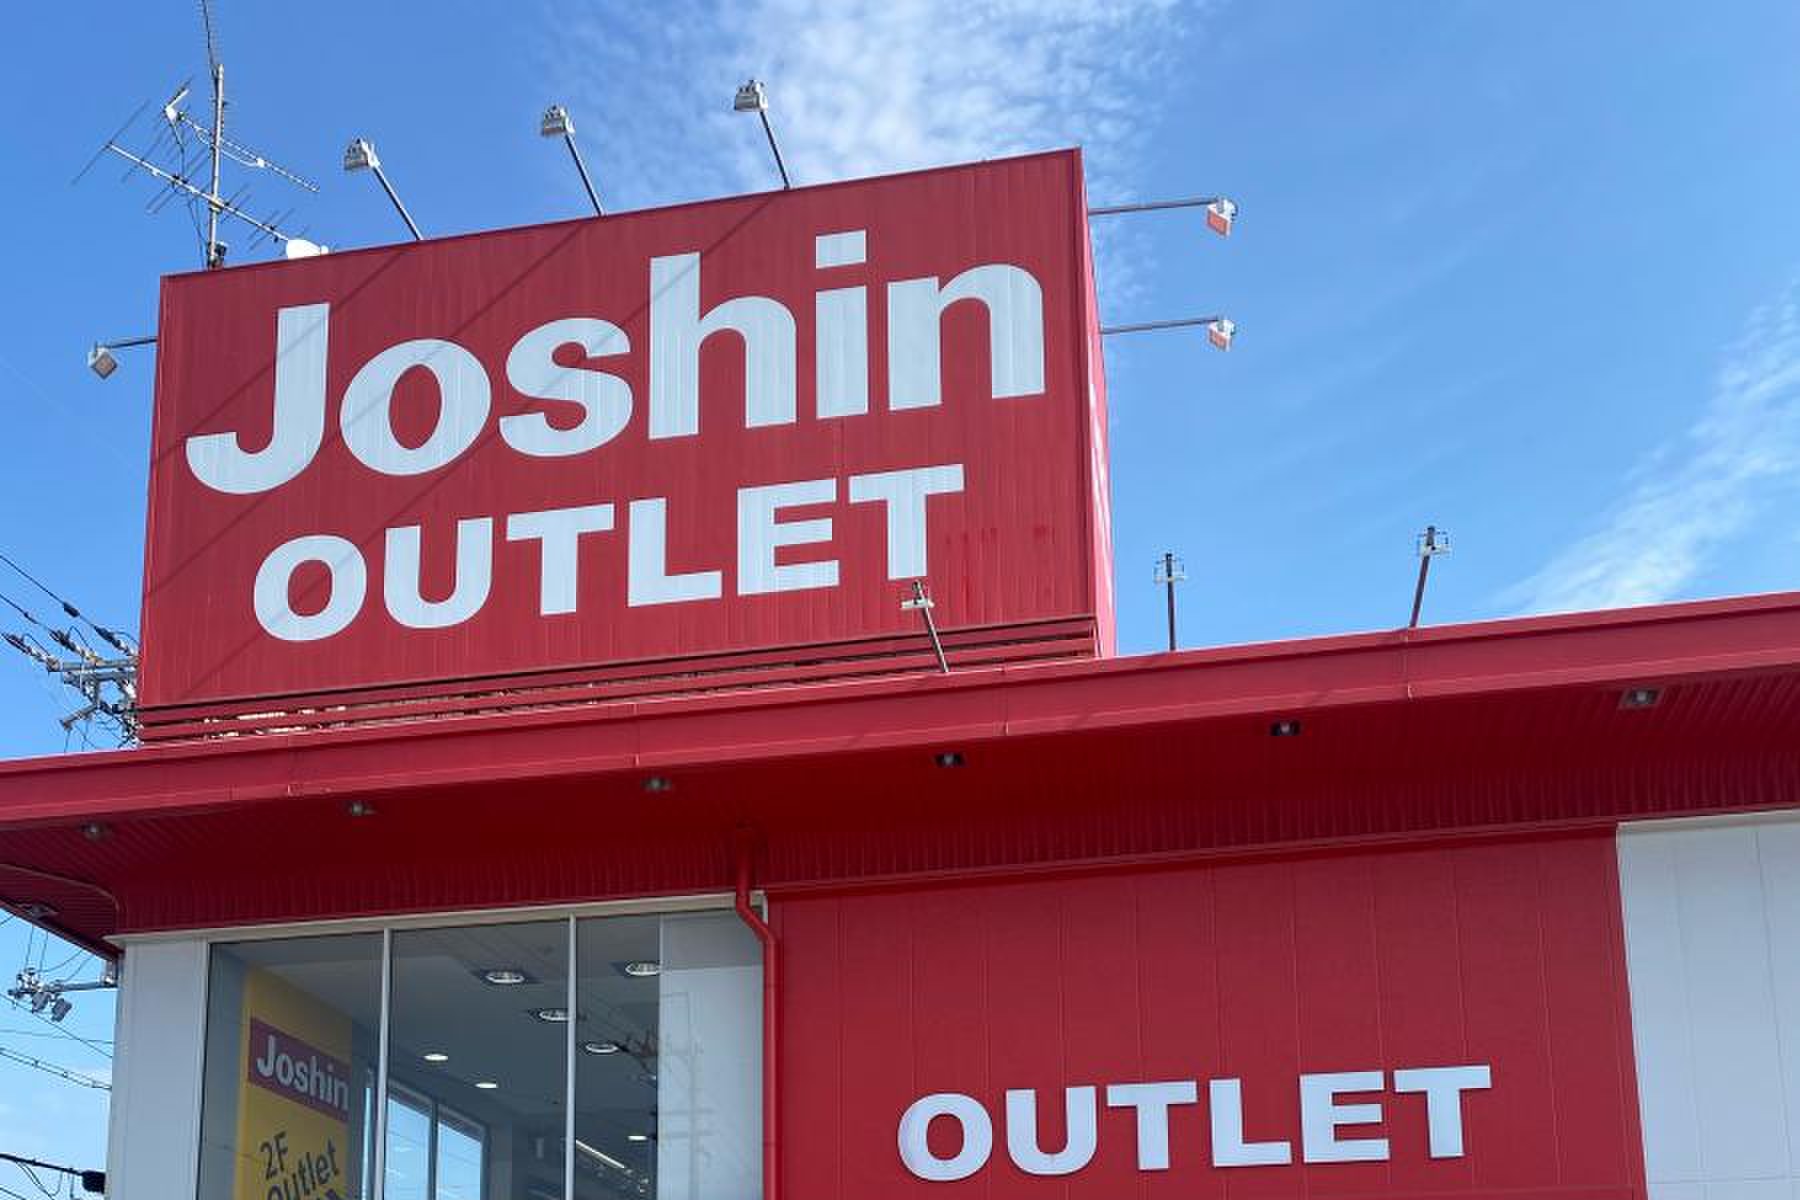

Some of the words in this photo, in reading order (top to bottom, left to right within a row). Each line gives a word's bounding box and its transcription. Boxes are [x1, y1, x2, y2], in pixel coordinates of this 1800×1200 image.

[185, 229, 1046, 495] Joshin
[253, 463, 964, 642] OUTLET
[256, 1034, 348, 1111] Joshin
[897, 1065, 1491, 1181] OUTLET
[260, 1131, 289, 1180] 2F
